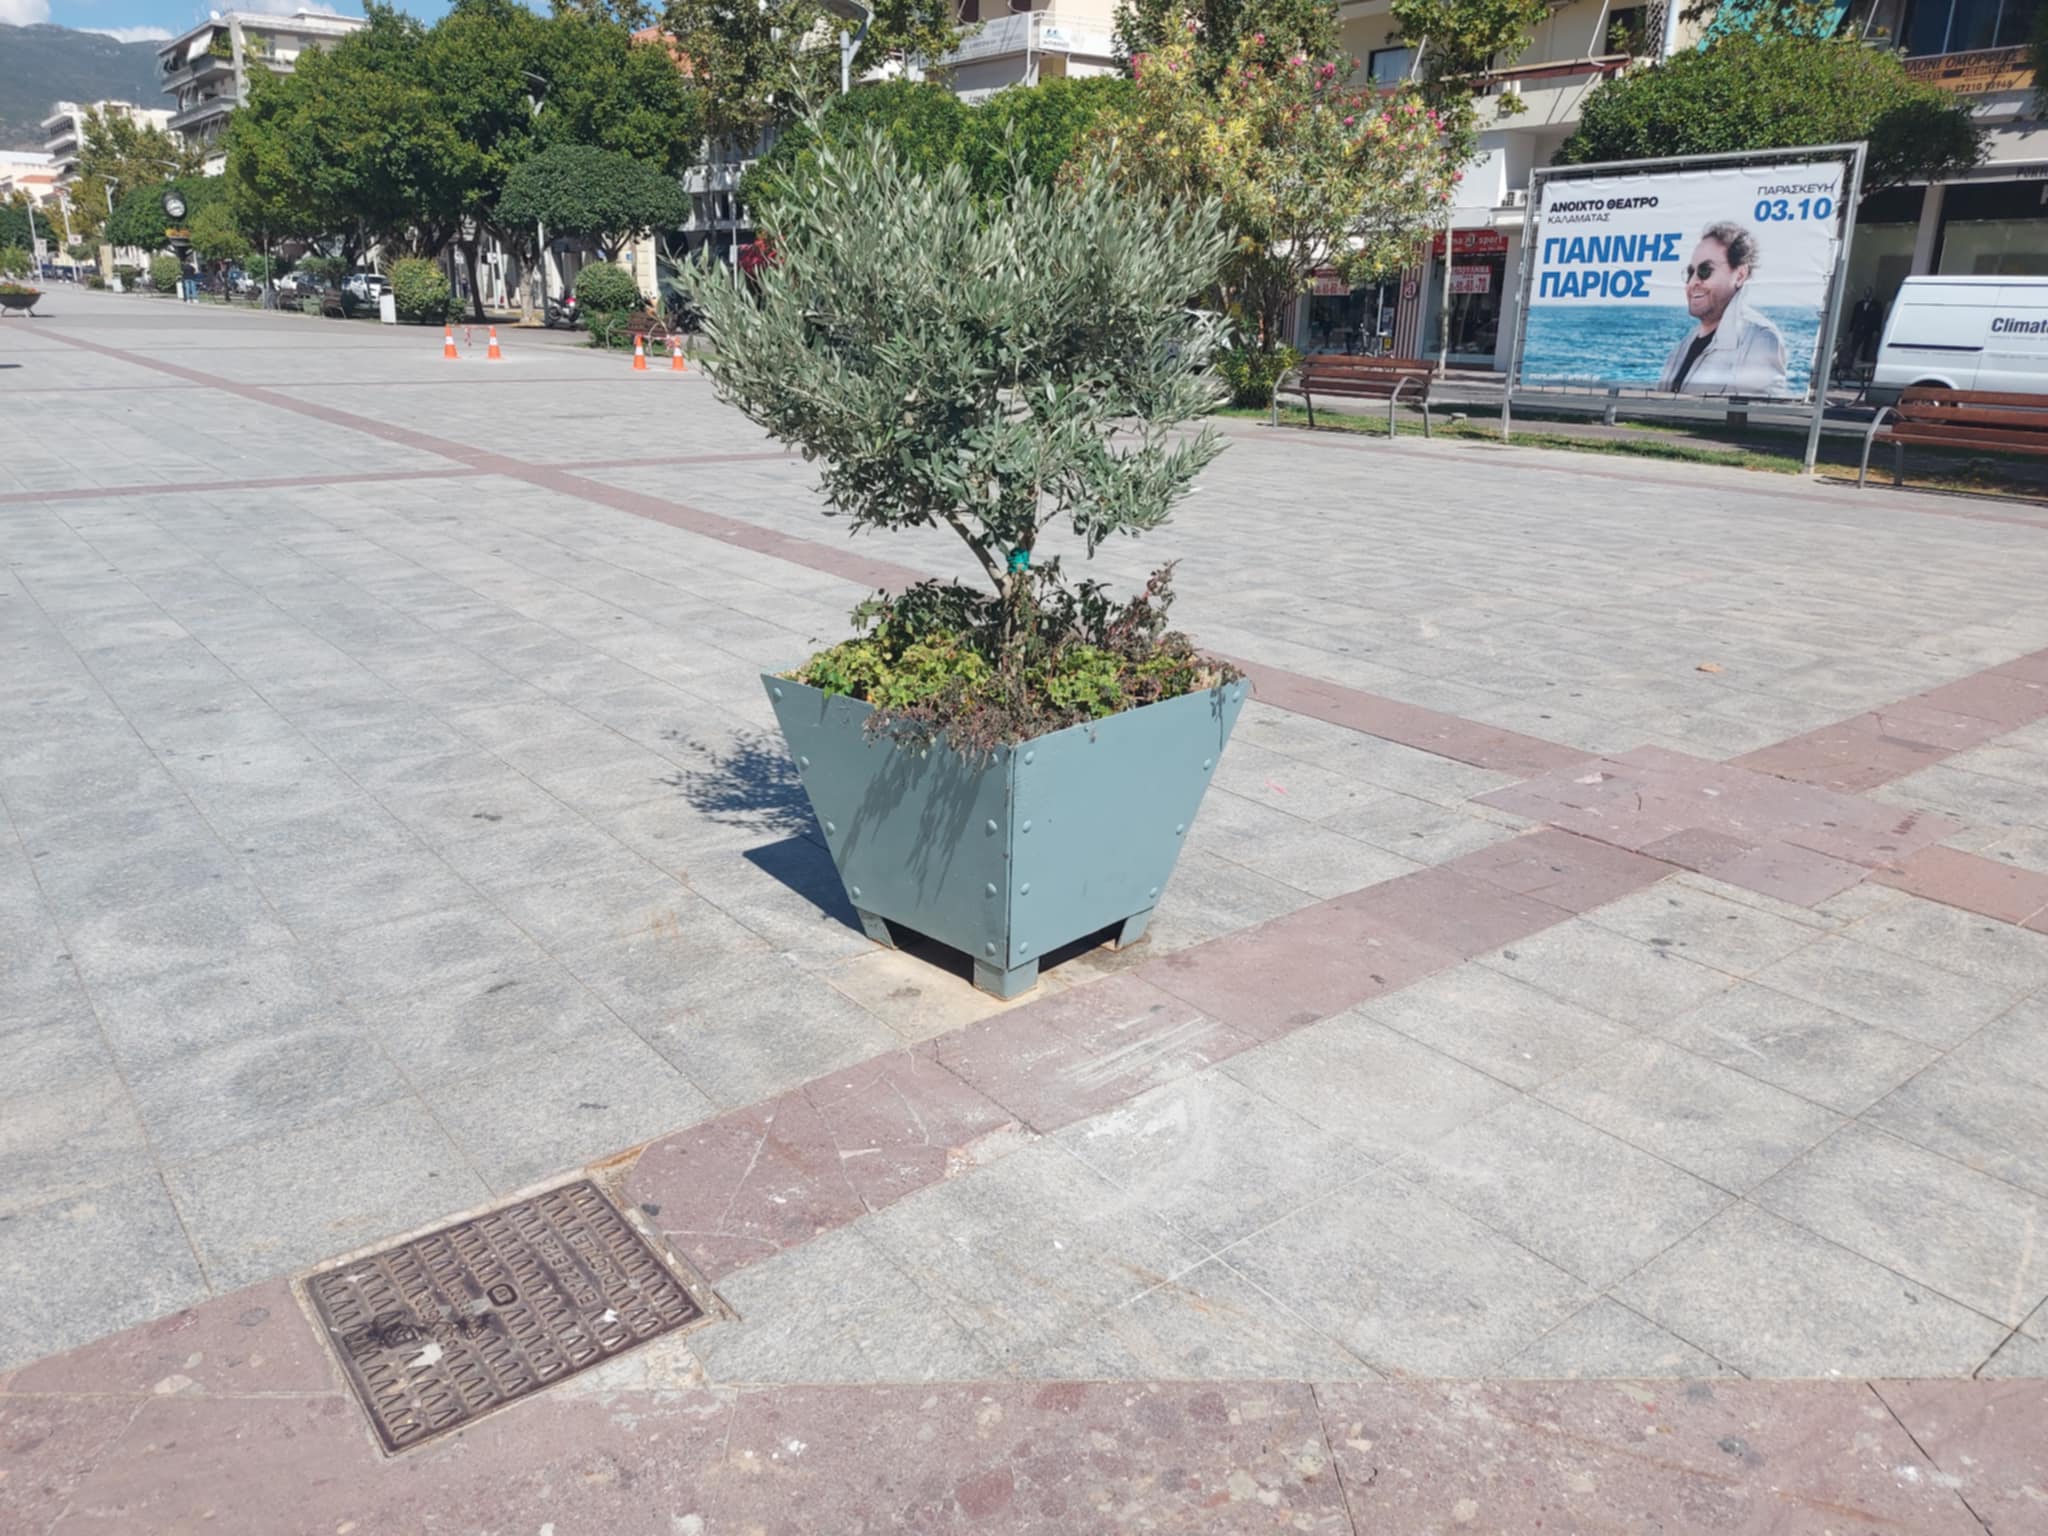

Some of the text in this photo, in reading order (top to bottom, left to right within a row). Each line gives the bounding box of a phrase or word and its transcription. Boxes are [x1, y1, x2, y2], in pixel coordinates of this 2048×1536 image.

[1757, 183, 1834, 195] ΠΑΡΑΣΚΕΥΗ
[1550, 196, 1659, 213] ΑΝΟΙΧΤΟ ΘΕΑΤΡΟ
[1754, 197, 1832, 222] 03.10
[1547, 213, 1611, 224] ΚΑΛΑΜΑΤΑΣ
[1543, 233, 1682, 264] ΓΙΑΝΝΗΣ
[1539, 269, 1652, 298] ΠΑΡΙΟΣ
[1991, 317, 2048, 334] Climat
